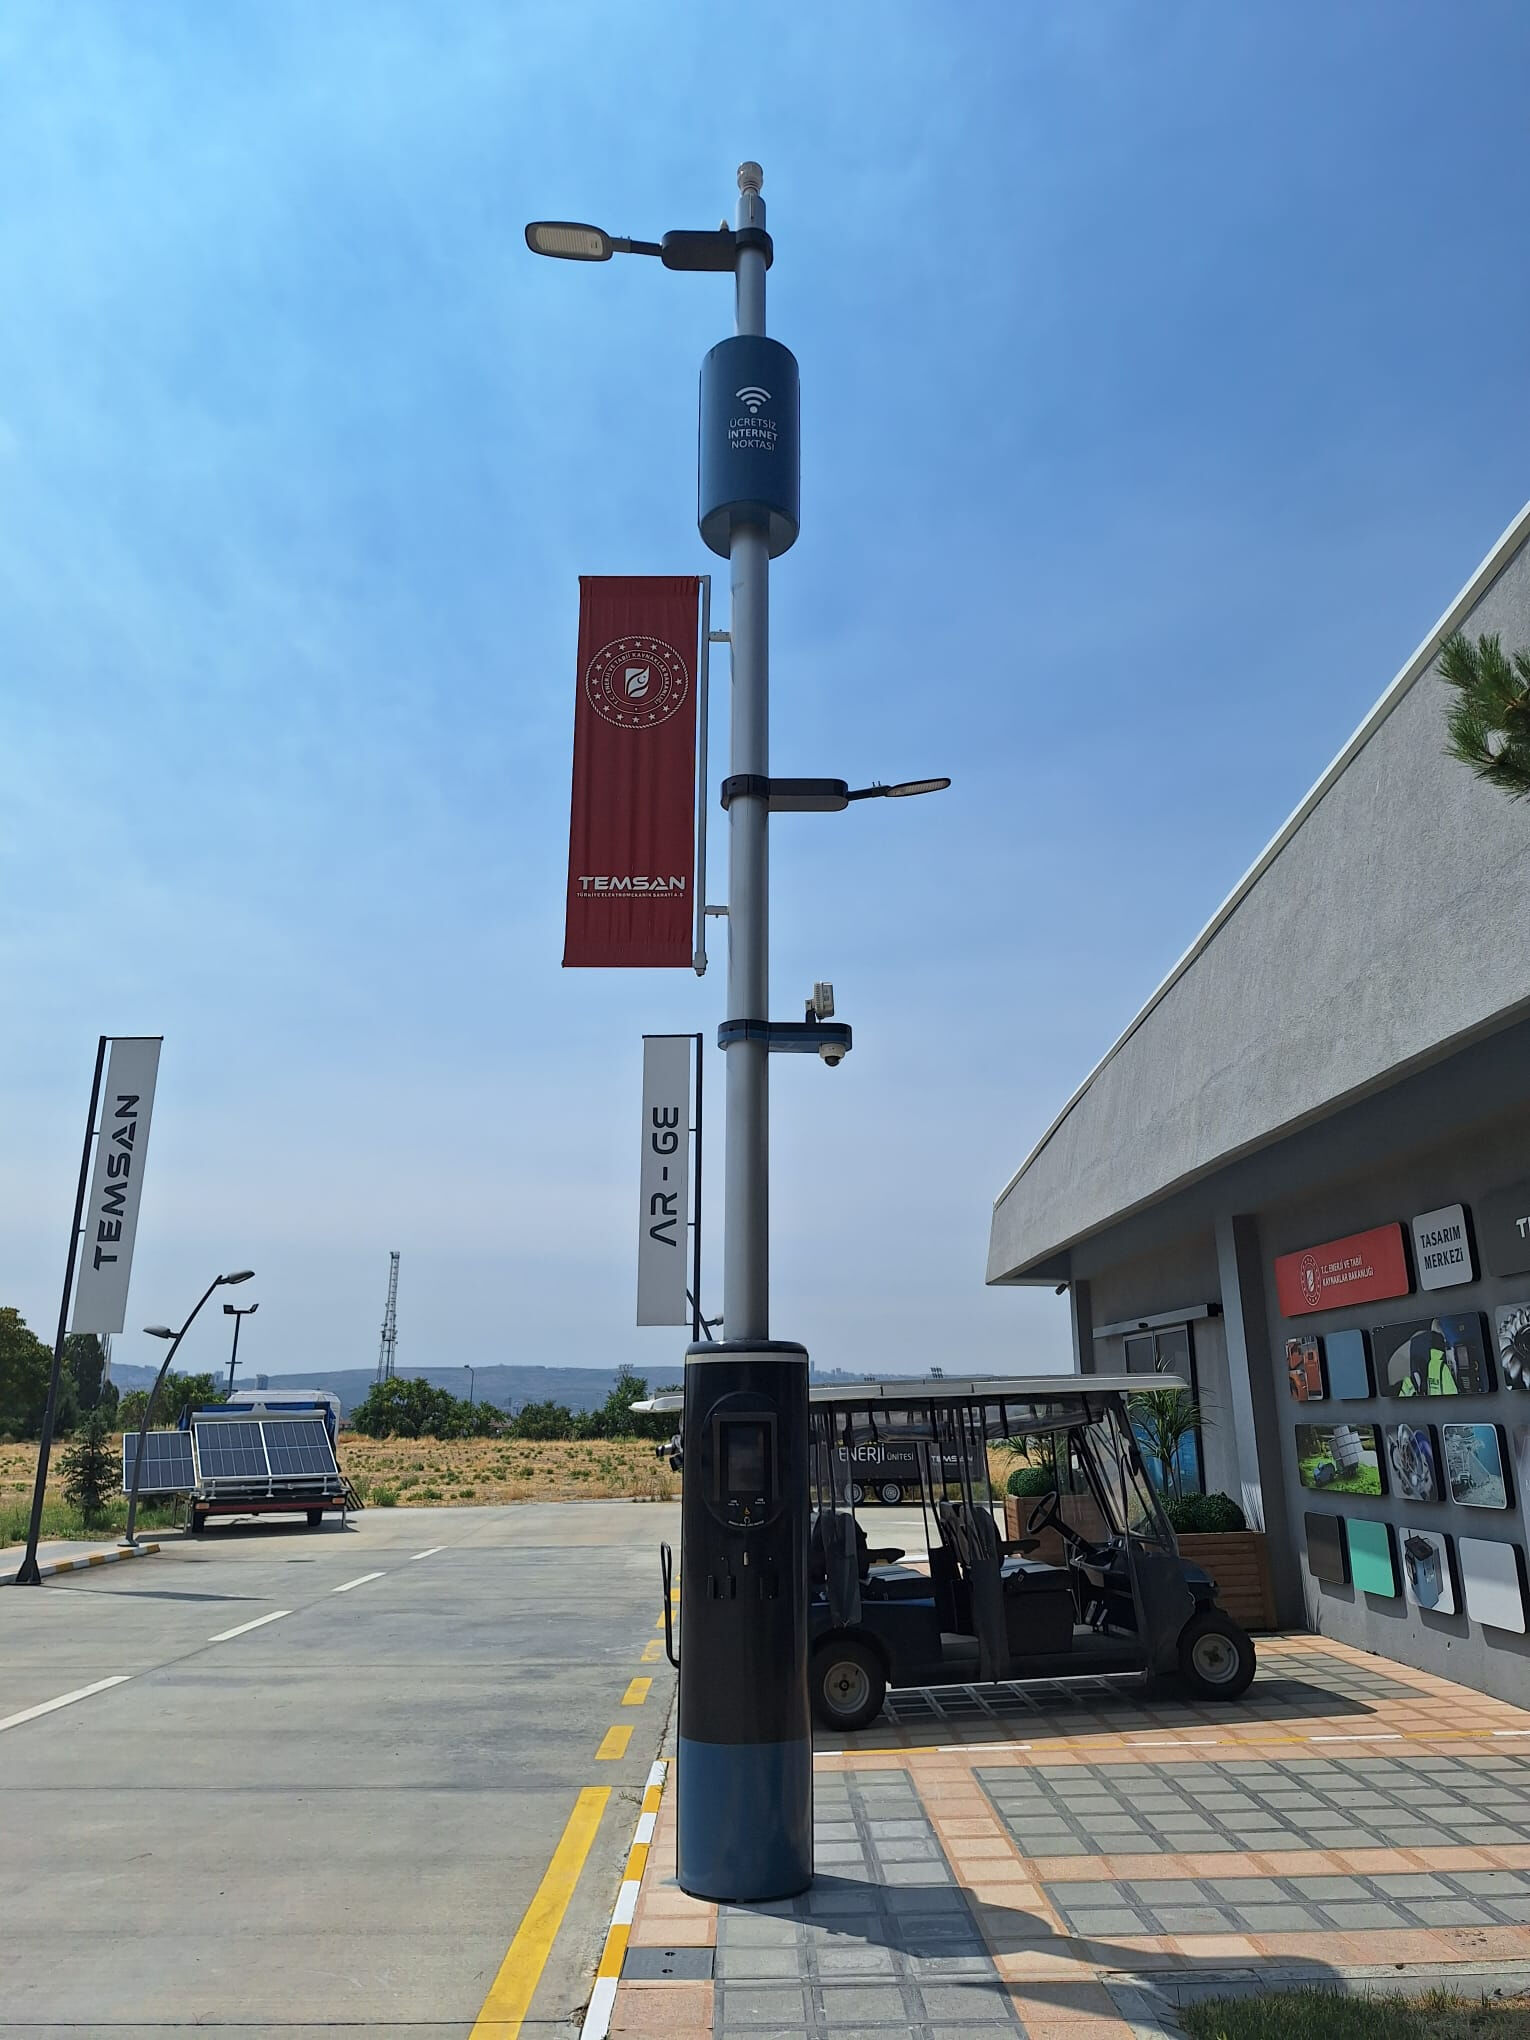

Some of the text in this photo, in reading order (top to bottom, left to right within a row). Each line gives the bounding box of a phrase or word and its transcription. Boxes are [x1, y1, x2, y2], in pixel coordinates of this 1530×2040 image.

[729, 416, 777, 431] ÜCRETSİZ
[731, 439, 775, 452] NOKTASI
[578, 876, 686, 891] TEMSAN
[93, 1095, 140, 1271] TEMSAN
[1420, 1225, 1461, 1249] TASARIM
[1424, 1247, 1464, 1270] MERKEZİ
[838, 1443, 885, 1464] ENERJİ
